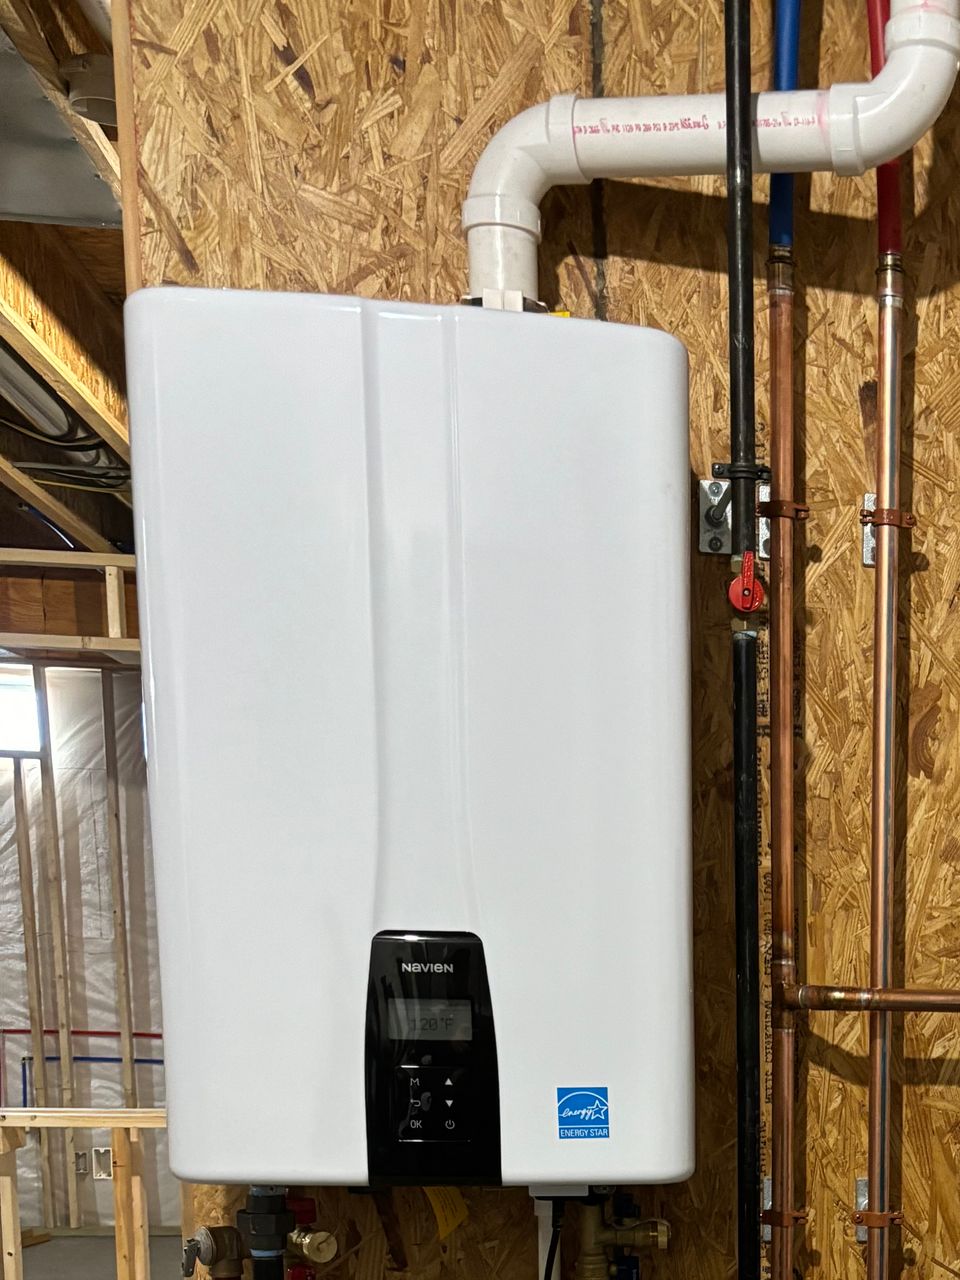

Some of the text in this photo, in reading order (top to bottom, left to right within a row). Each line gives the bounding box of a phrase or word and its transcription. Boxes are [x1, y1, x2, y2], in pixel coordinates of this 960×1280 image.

[410, 1077, 420, 1087] M
[410, 1119, 423, 1129] OK
[560, 1128, 609, 1137] ENERGY STAR
